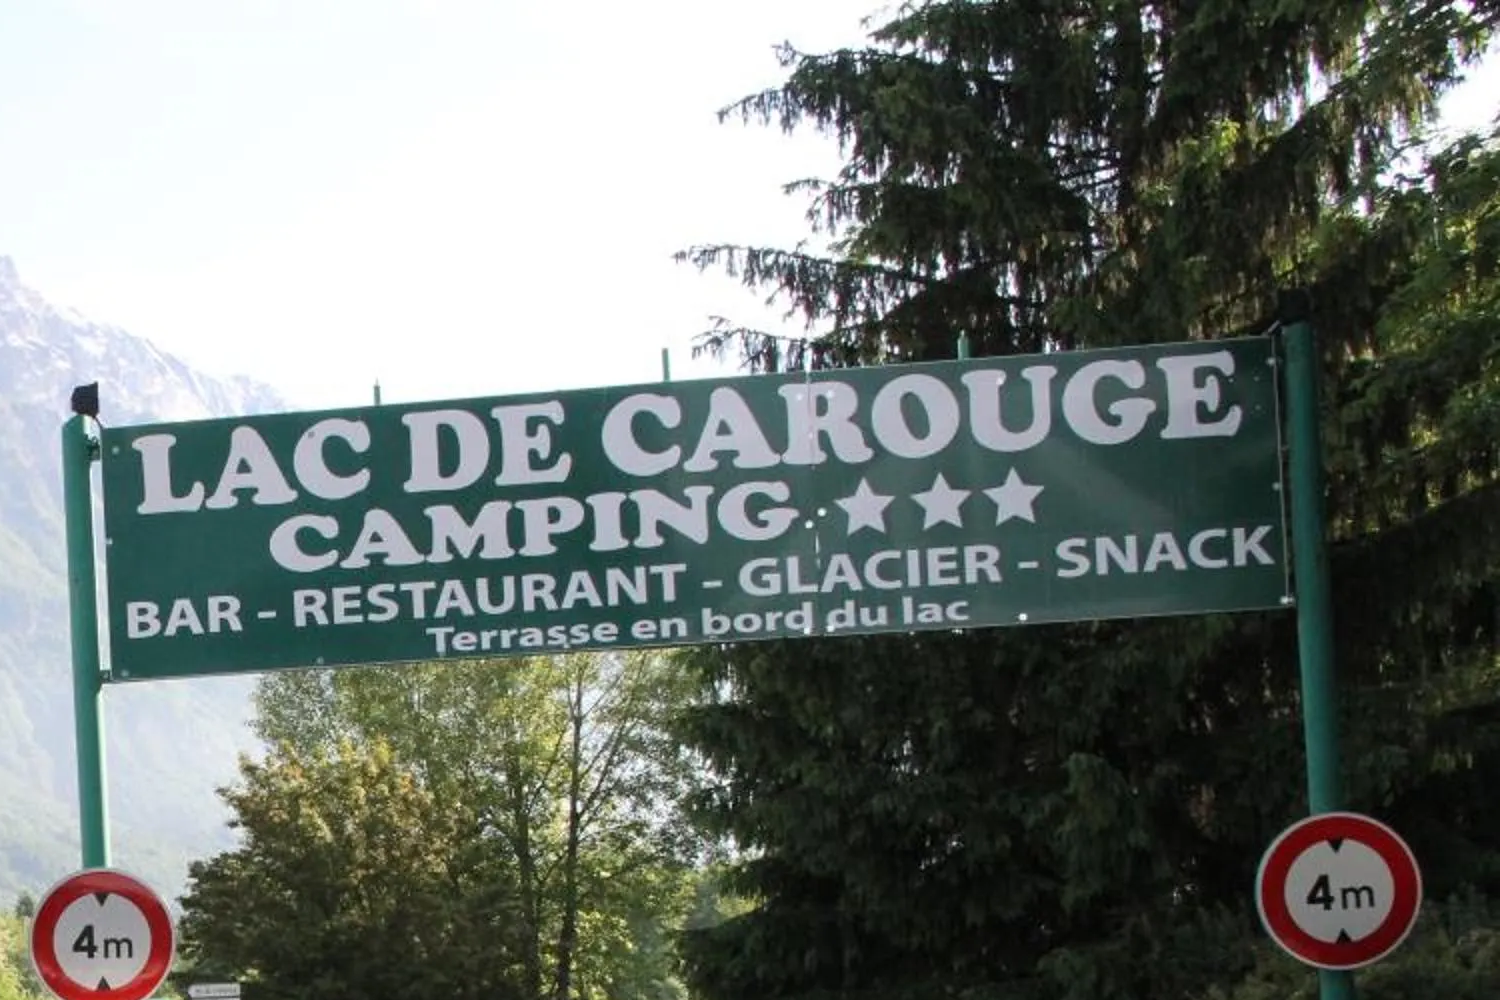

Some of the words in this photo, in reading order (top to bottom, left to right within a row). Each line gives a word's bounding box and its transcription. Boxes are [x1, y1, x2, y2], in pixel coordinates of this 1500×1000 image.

[131, 417, 371, 515] LAC
[401, 399, 572, 493] DE
[601, 350, 1243, 477] CAROUGE
[268, 480, 800, 573] CAMPING
[126, 595, 243, 639] BAR
[292, 562, 688, 628] RESTAURANT
[737, 543, 1002, 598] GLACIER
[1055, 524, 1276, 579] SNACK
[425, 621, 628, 653] Terrasse
[630, 616, 688, 639] en
[700, 602, 815, 636] bord
[825, 600, 889, 632] du
[901, 597, 971, 626] lac
